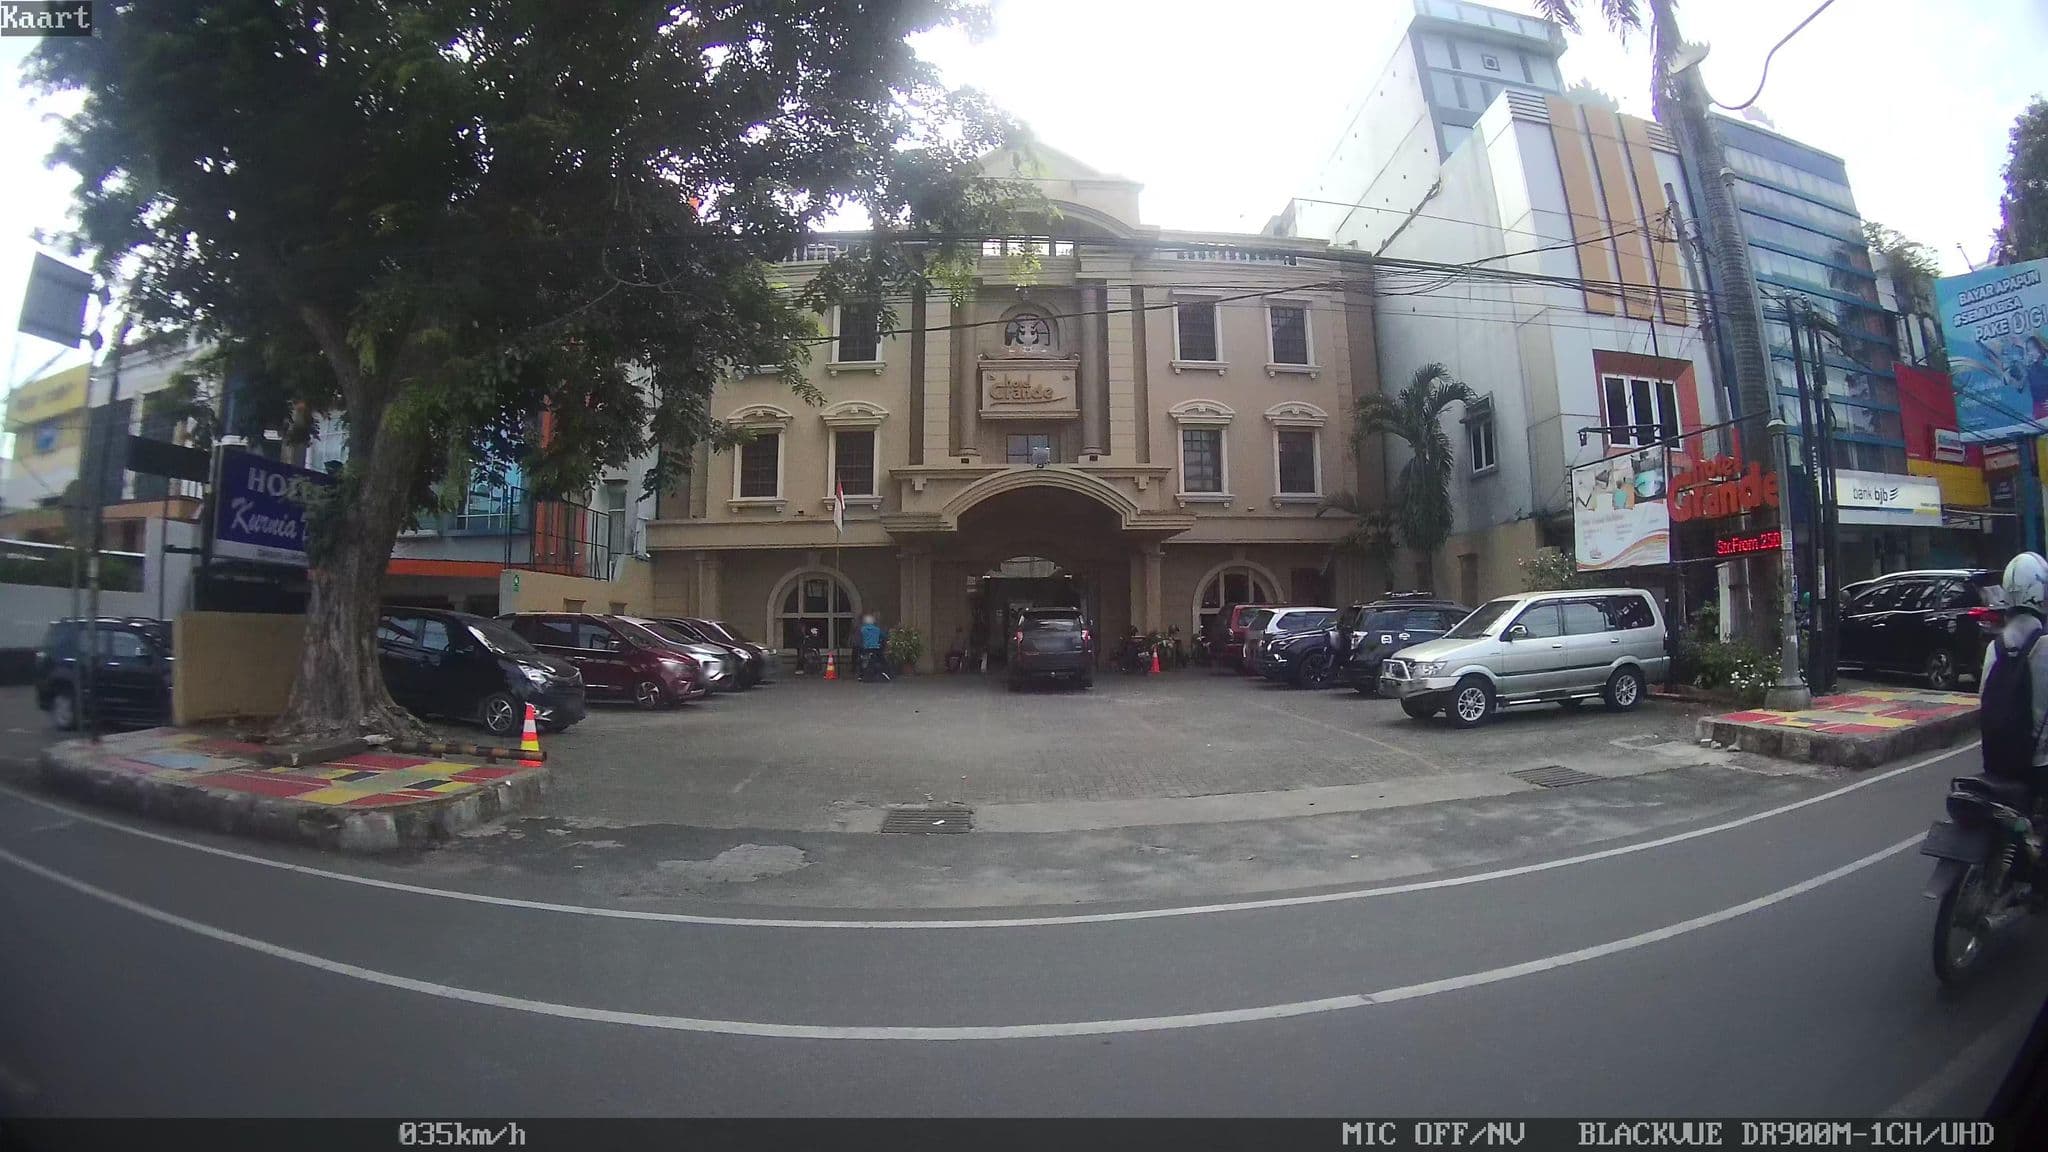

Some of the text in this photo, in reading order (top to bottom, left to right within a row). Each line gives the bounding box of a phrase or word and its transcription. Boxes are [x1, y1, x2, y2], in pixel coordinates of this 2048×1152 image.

[1958, 269, 2041, 307] BAYAR APAPUN
[1975, 318, 2009, 342] PAKE
[989, 382, 1054, 400] Grande
[1667, 460, 1779, 523] Grande
[1853, 487, 1889, 505] bank bjb
[230, 496, 298, 539] Kurnia
